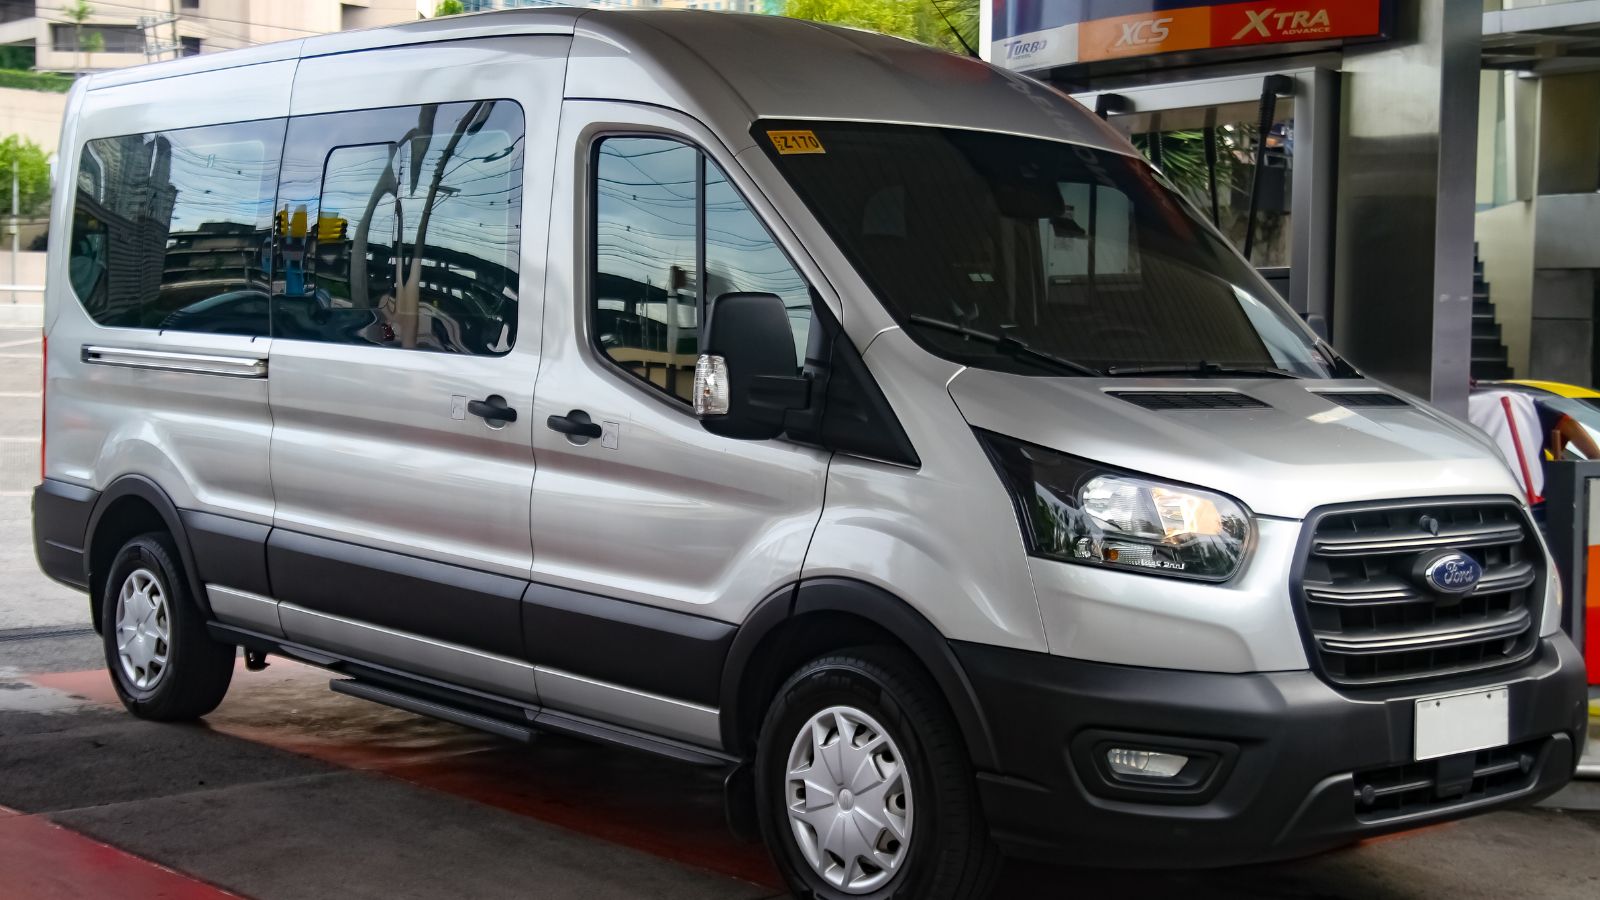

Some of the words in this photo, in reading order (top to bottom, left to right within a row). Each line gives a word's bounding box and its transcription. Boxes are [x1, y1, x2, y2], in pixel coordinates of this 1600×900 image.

[1115, 17, 1174, 47] XCS
[1232, 8, 1330, 40] XTRA
[1281, 27, 1331, 35] ADVANCE
[1004, 40, 1047, 59] TURBO
[1444, 561, 1474, 585] Ford
